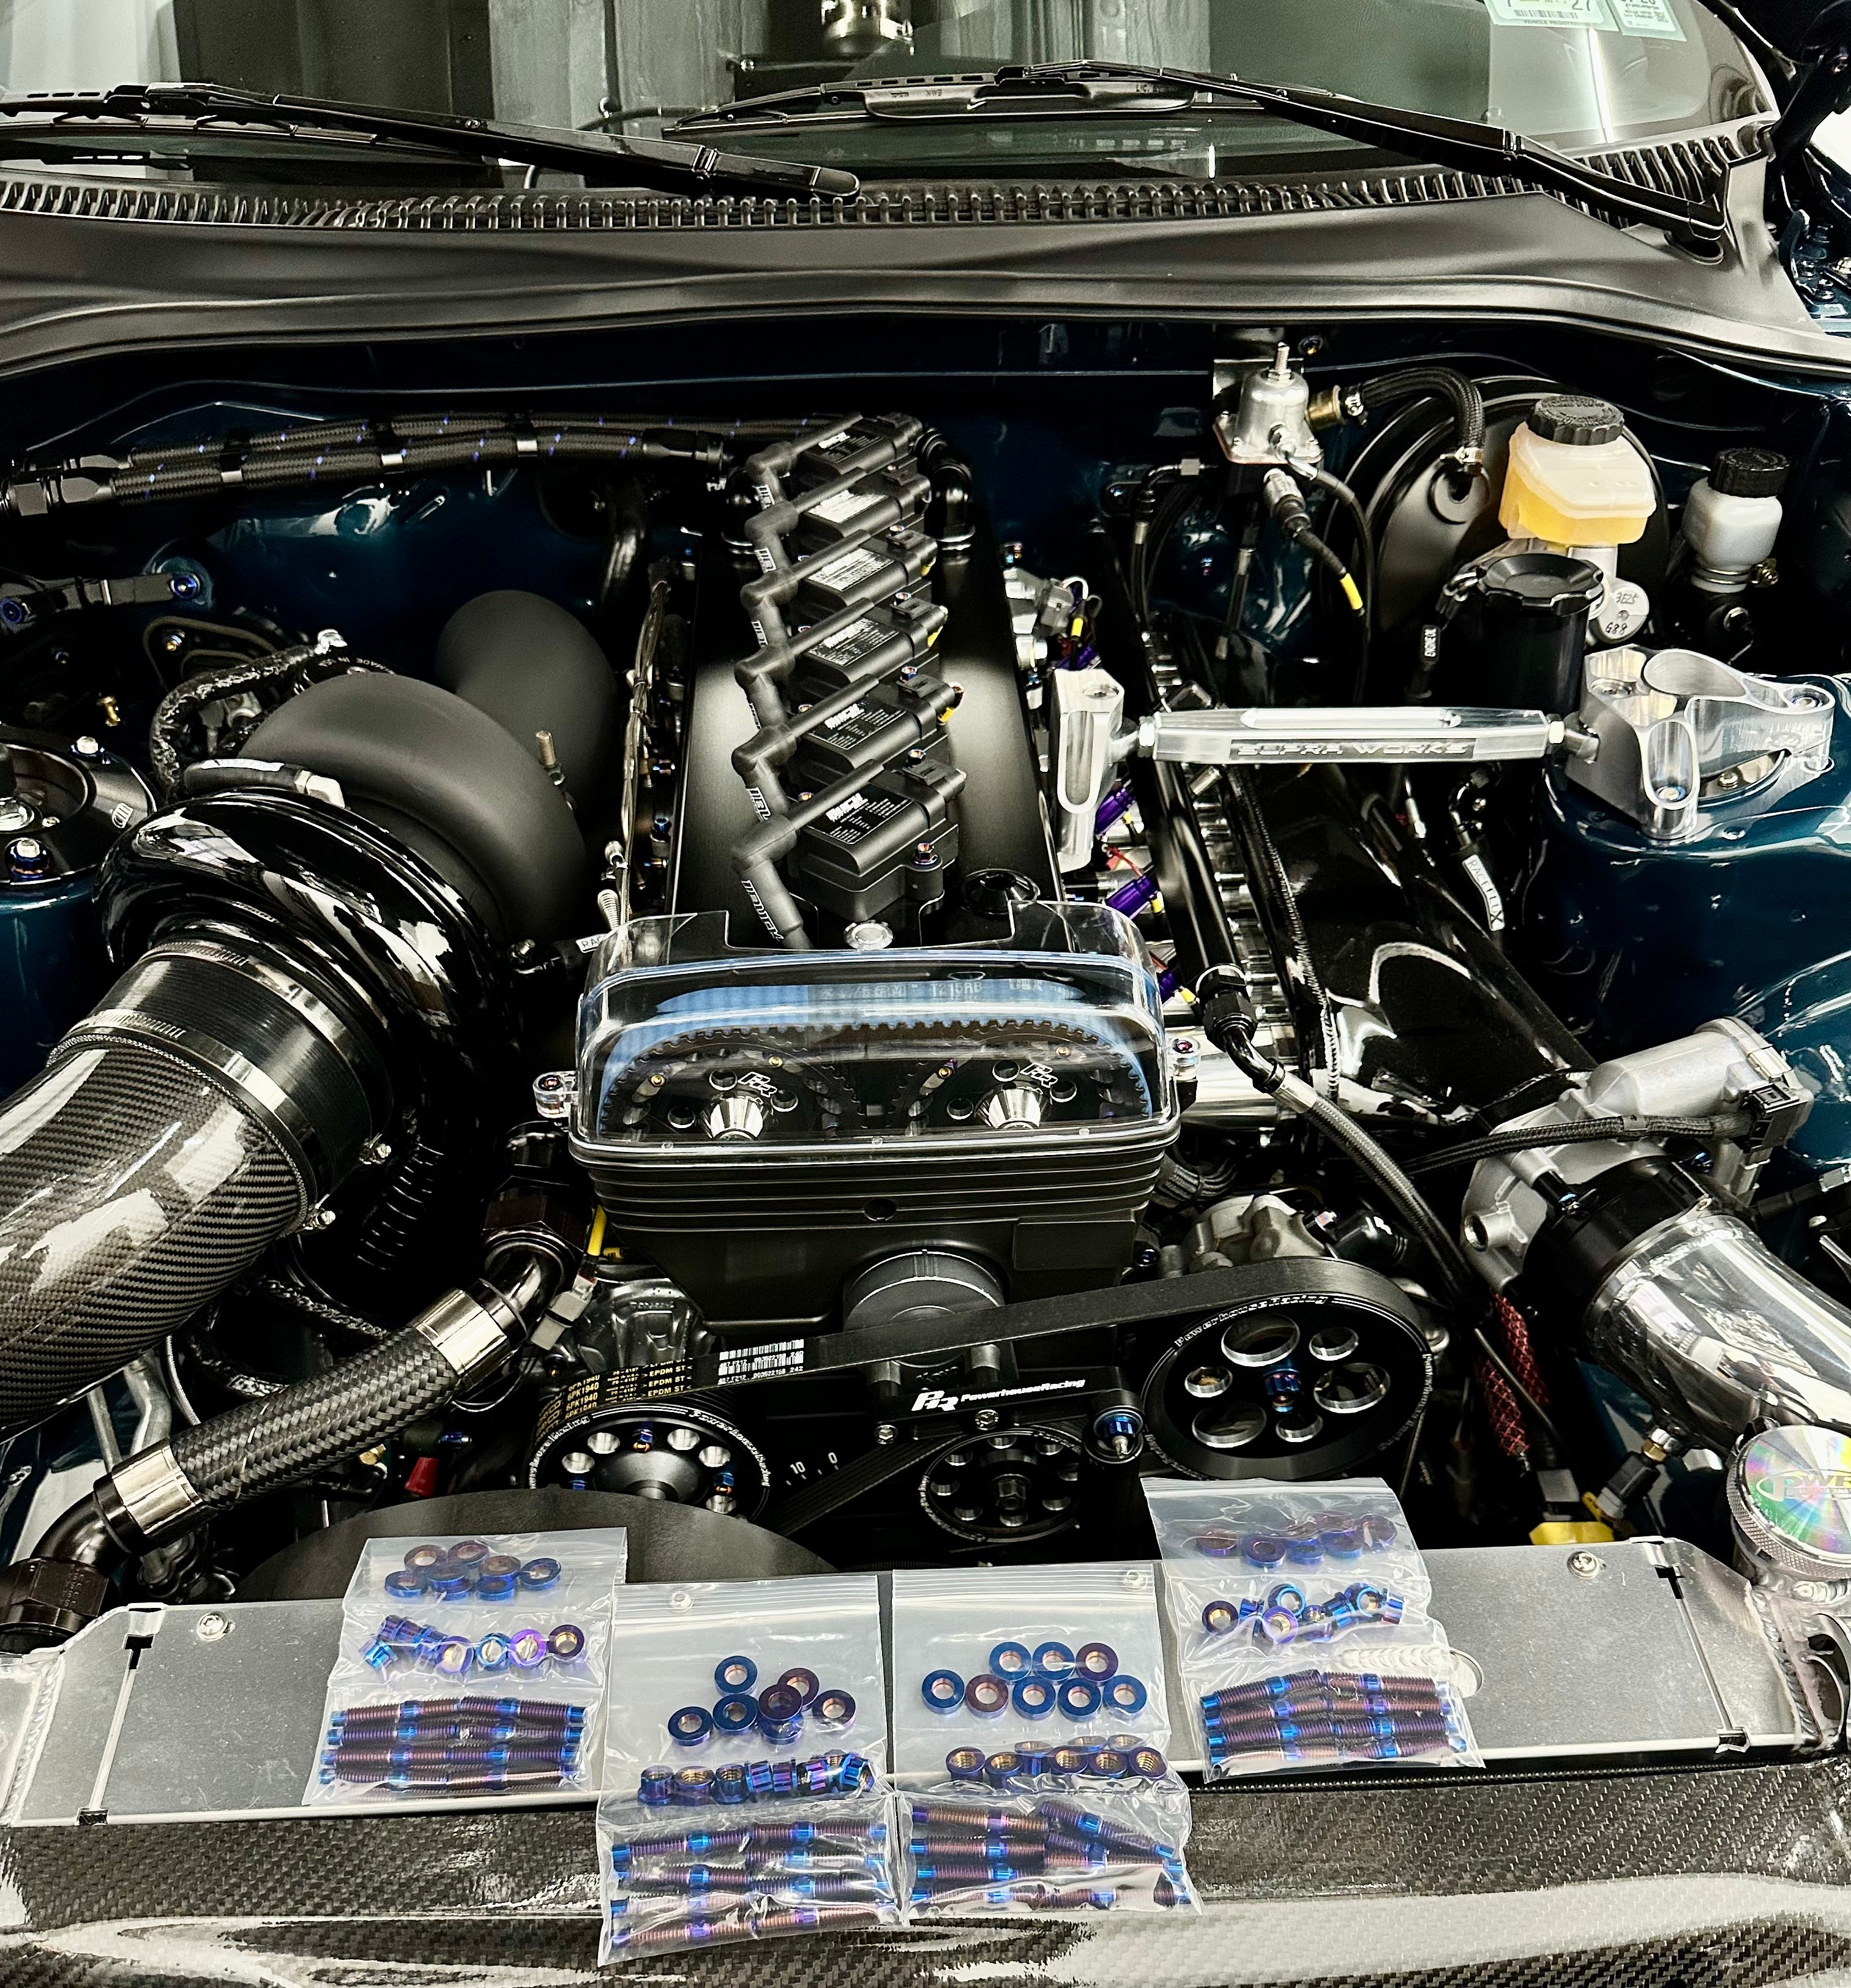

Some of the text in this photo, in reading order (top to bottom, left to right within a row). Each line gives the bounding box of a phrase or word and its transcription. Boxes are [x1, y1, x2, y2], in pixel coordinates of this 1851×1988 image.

[1237, 741, 1468, 757] SUPRA WORKS
[649, 1364, 686, 1377] EPDM ST
[648, 1377, 673, 1387] EPDM
[674, 1374, 685, 1383] ST
[567, 1382, 600, 1401] 6PK1940
[647, 1388, 672, 1397] EPDM
[673, 1384, 684, 1393] ST
[960, 1380, 1086, 1402] PowerhouseRacing
[566, 1392, 599, 1412] 6PK1940
[828, 1452, 838, 1464] 0
[790, 1461, 806, 1474] 10
